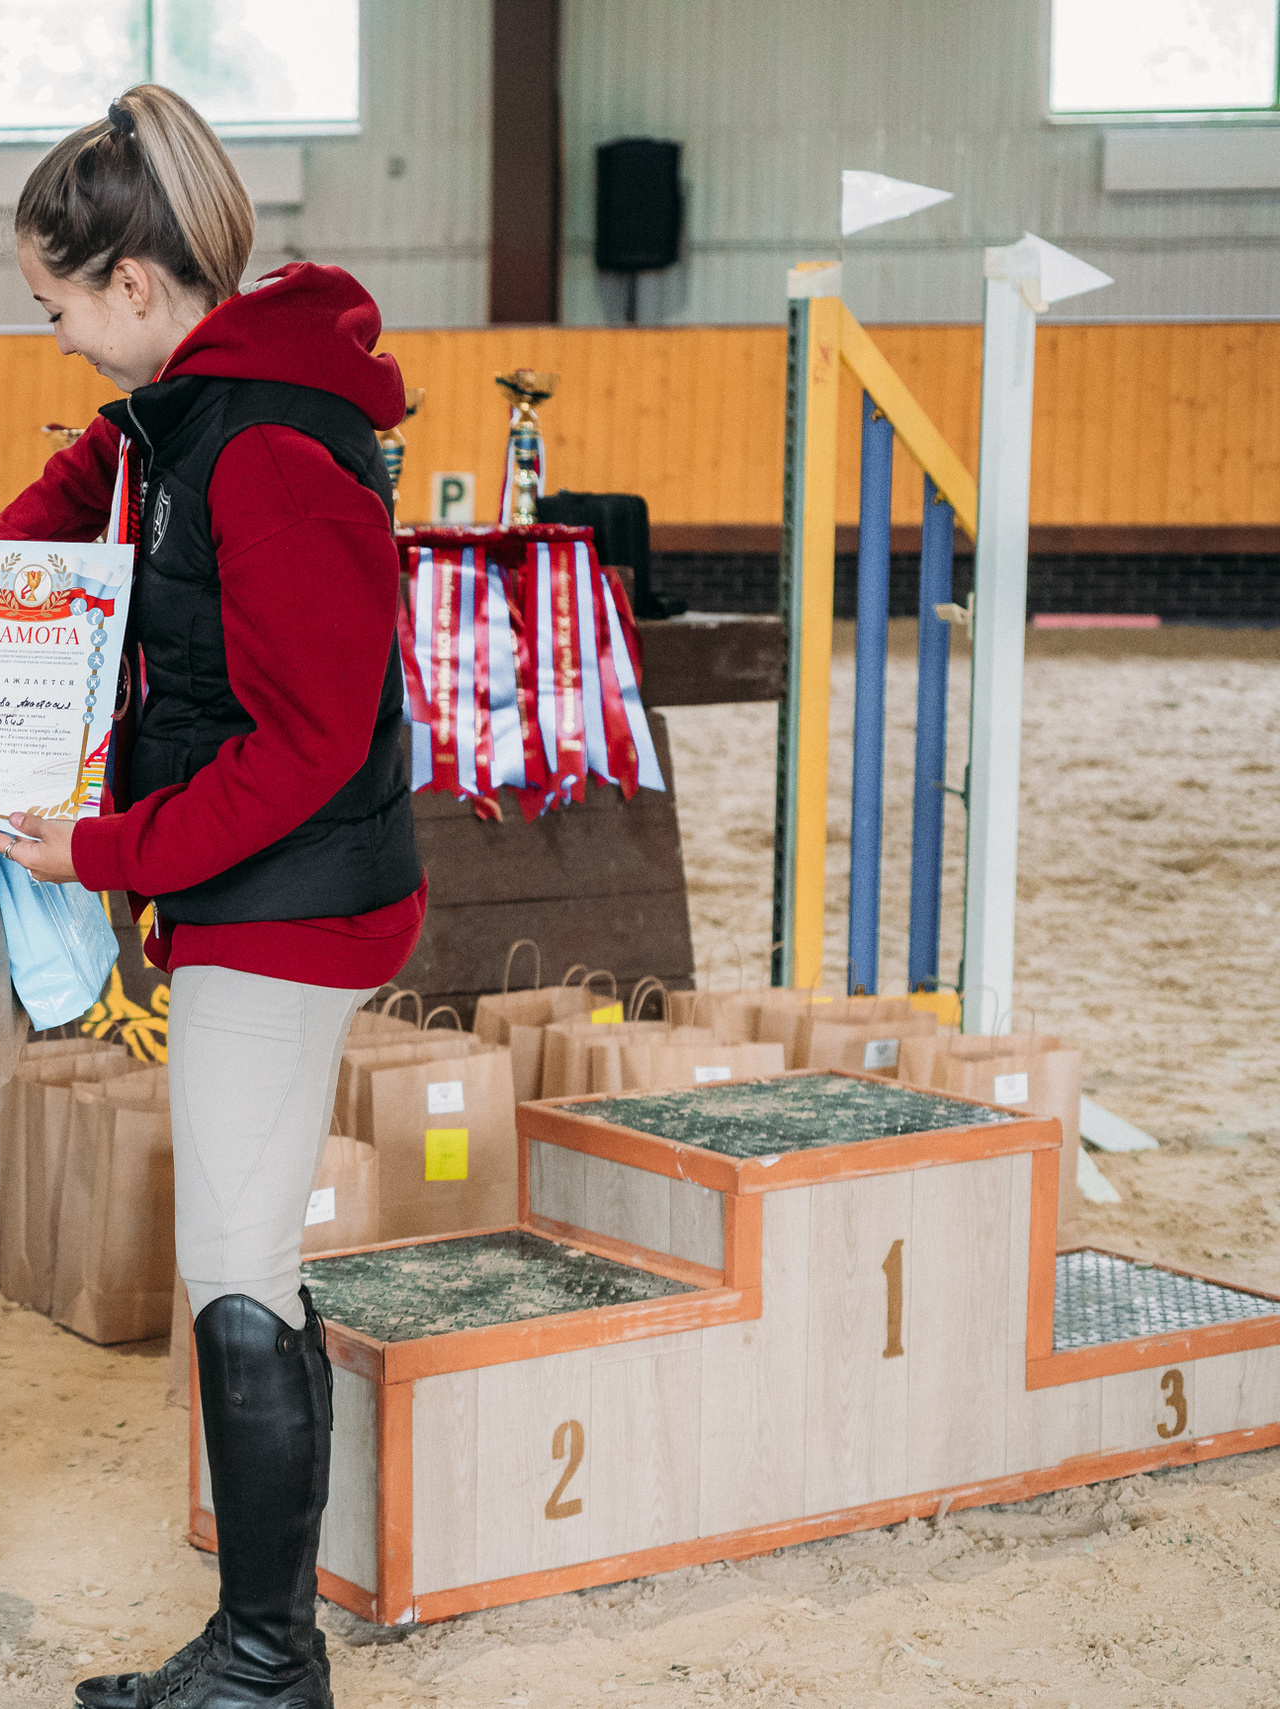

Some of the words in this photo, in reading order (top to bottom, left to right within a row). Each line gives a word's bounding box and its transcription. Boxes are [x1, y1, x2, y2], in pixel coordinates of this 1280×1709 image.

[441, 478, 465, 518] P
[881, 1239, 905, 1359] 1
[1156, 1368, 1188, 1440] 3
[544, 1419, 585, 1522] 2
